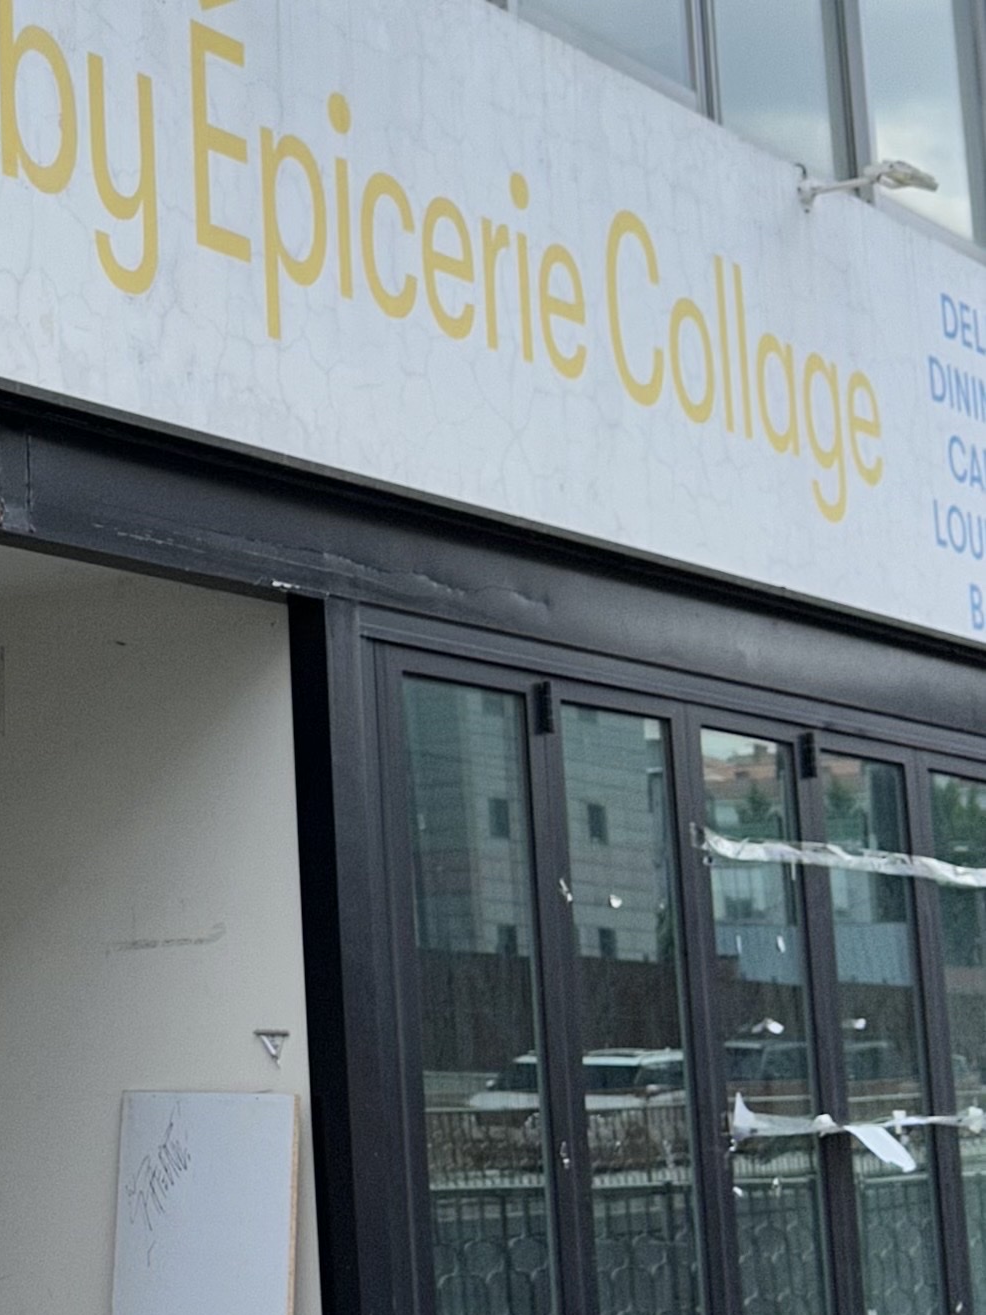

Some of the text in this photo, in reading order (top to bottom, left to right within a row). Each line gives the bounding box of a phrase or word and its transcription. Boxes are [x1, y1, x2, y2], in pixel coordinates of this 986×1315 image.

[189, 0, 588, 380] Épicerie
[606, 210, 883, 524] Collage
[948, 435, 986, 492] CA
[933, 498, 986, 560] LOU
